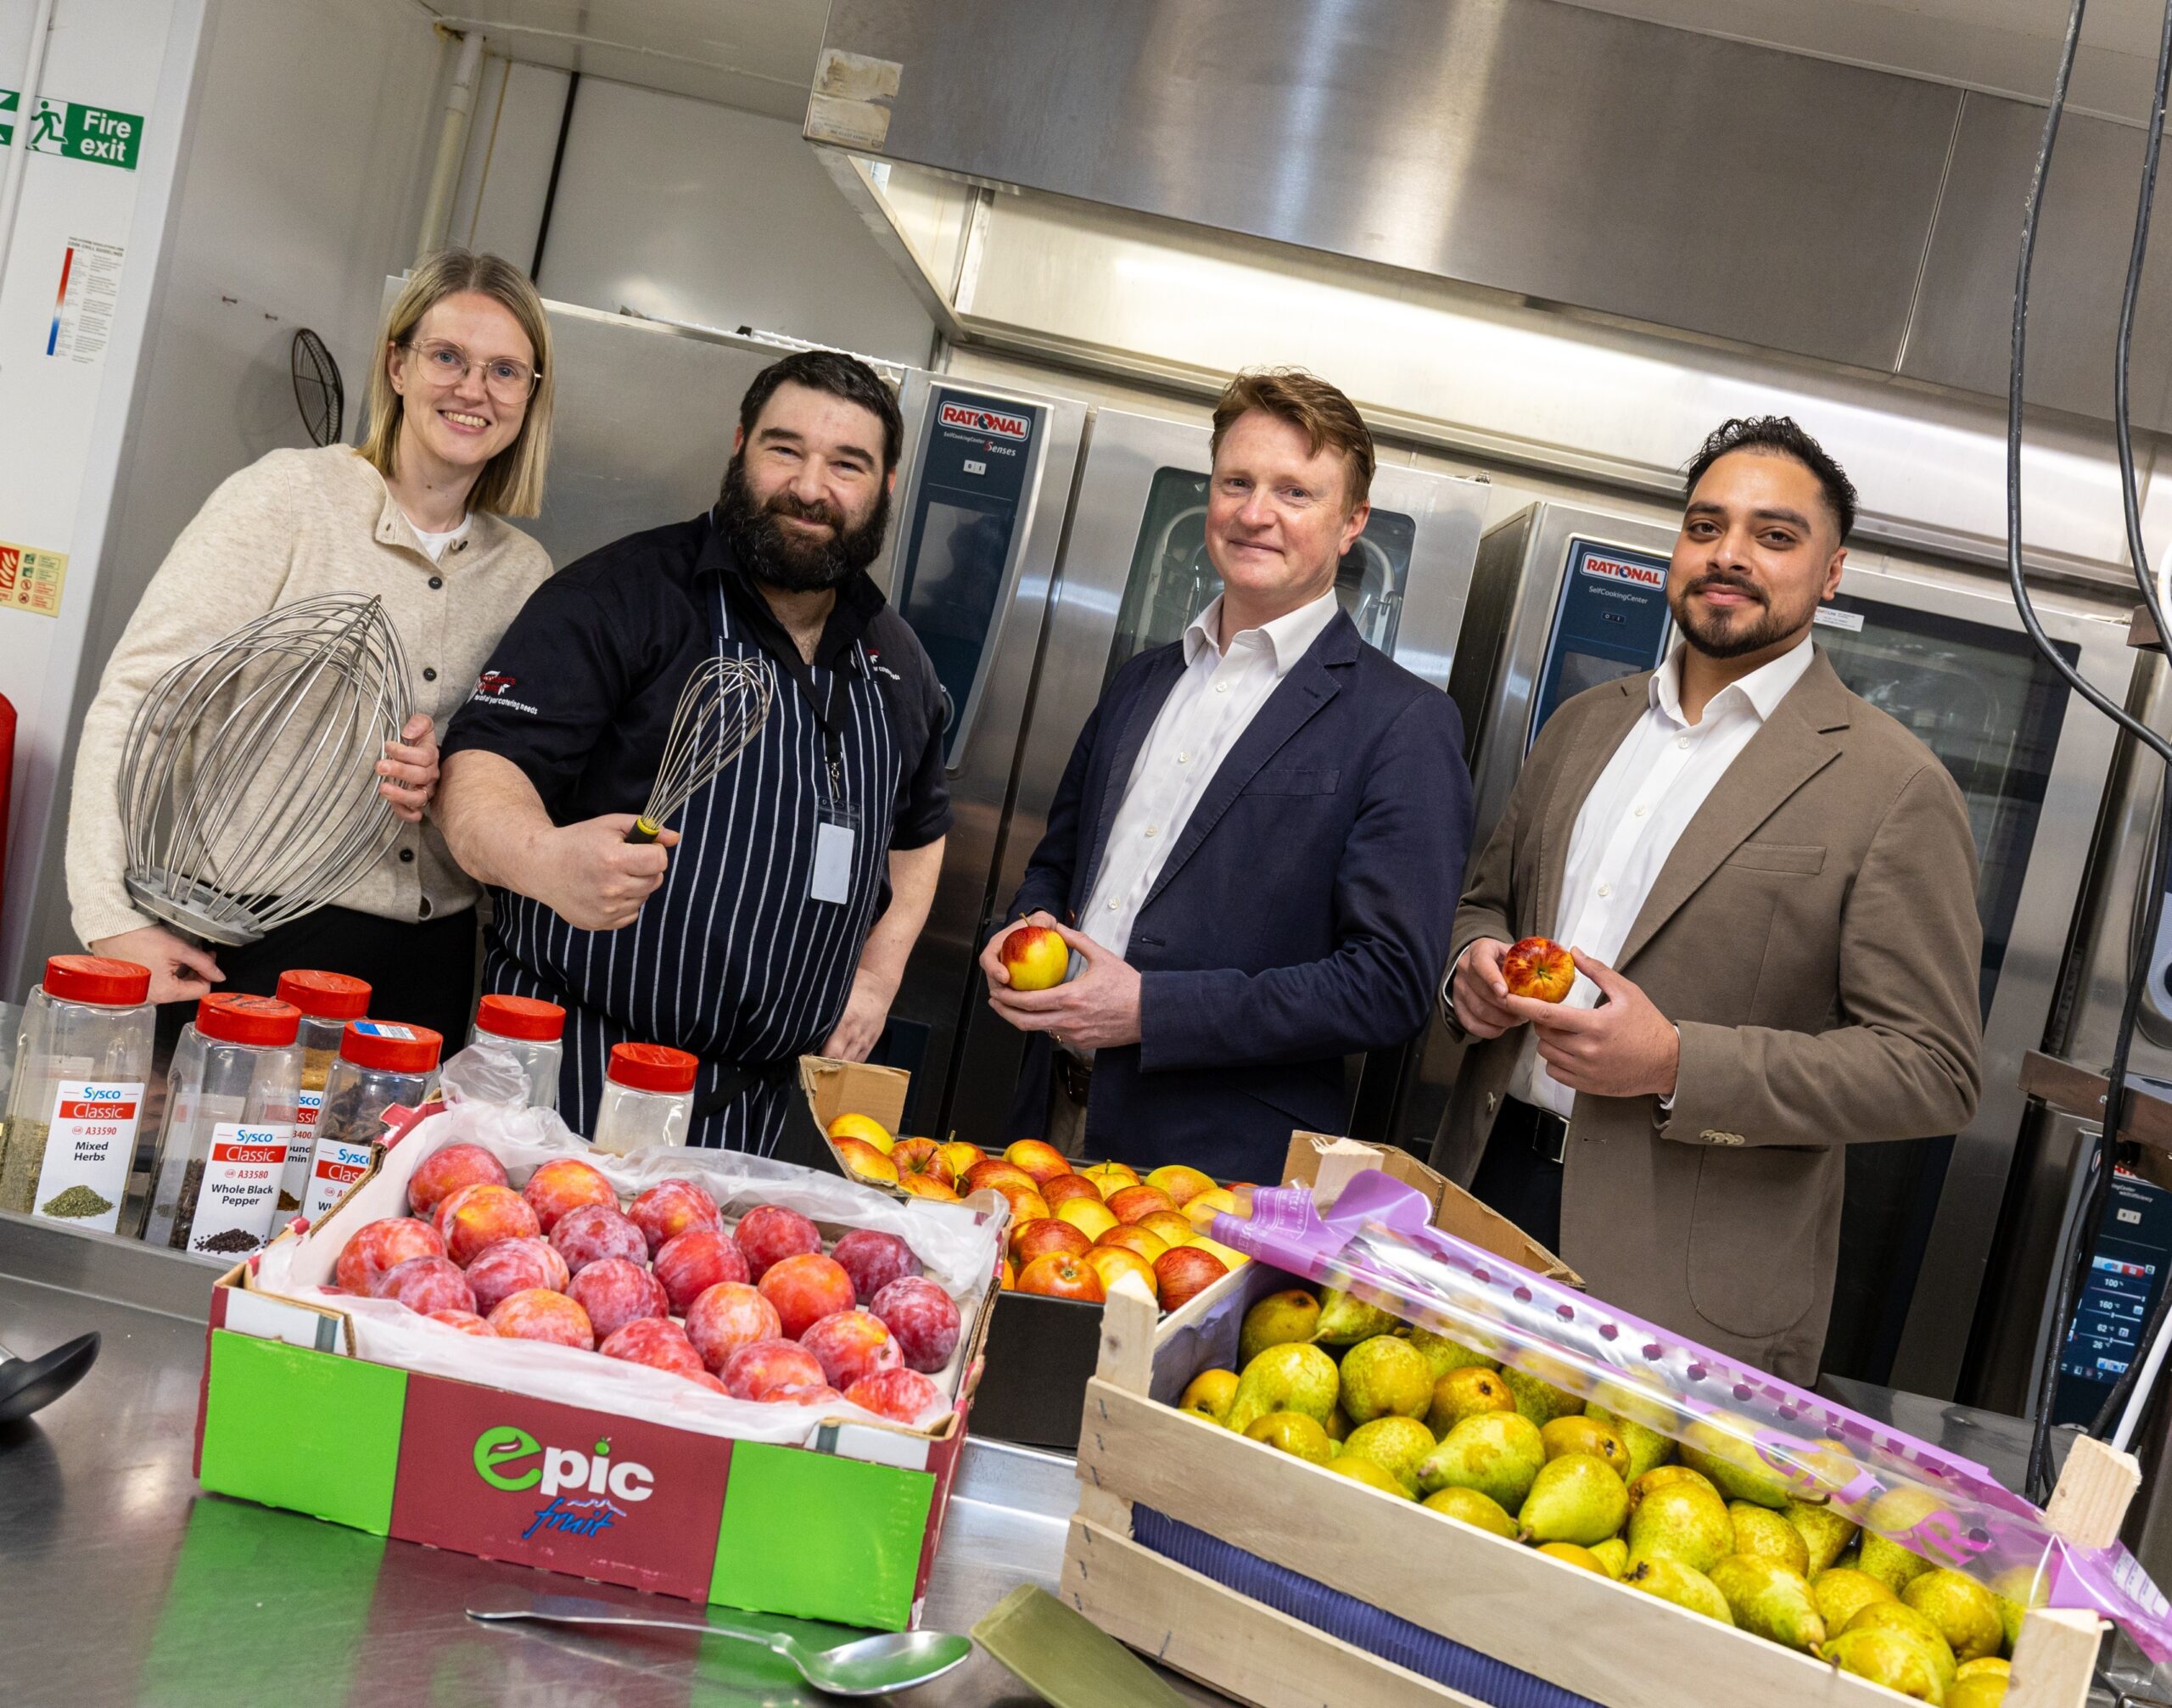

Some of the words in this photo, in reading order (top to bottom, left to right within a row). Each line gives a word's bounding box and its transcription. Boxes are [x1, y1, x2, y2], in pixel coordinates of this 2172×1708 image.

[83, 109, 132, 138] Fire
[80, 137, 126, 162] exit
[943, 406, 1024, 436] RATIONAL
[1587, 558, 1660, 585] RATIONAL
[1588, 585, 1648, 604] SelfCookingCenter
[498, 697, 520, 711] catering
[520, 703, 538, 715] needs
[83, 1086, 121, 1101] Sysco
[73, 1103, 124, 1118] Classic
[85, 1127, 117, 1135] A33590
[237, 1129, 273, 1144] Sysco
[75, 1141, 109, 1151] Mixed
[74, 1152, 105, 1162] Herbs
[226, 1146, 276, 1162] Classic
[238, 1169, 269, 1179] A33580
[328, 1164, 359, 1183] Clas
[211, 1184, 245, 1195] Whole
[247, 1185, 273, 1195] Black
[221, 1196, 260, 1207] Pepper
[2104, 1278, 2119, 1288] 100
[2099, 1300, 2113, 1310] 160
[2096, 1324, 2108, 1333] 62
[2092, 1341, 2103, 1350] 26
[473, 1425, 655, 1502] epic
[521, 1496, 614, 1540] fruit
